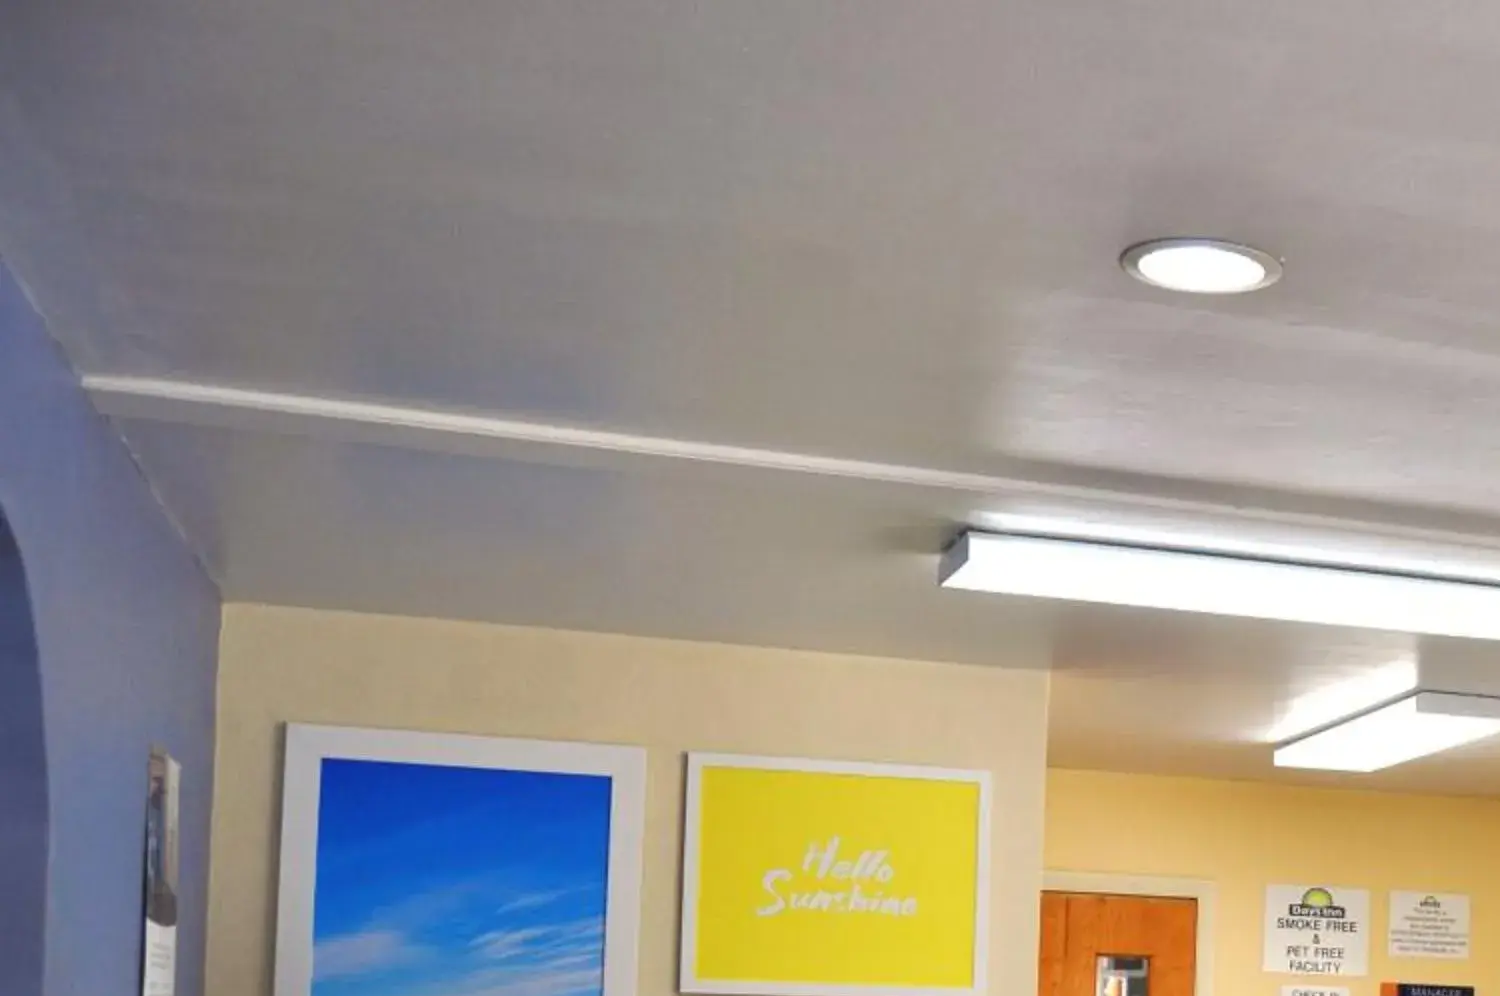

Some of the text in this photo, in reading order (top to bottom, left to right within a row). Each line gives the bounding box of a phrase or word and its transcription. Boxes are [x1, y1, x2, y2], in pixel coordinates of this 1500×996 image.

[802, 834, 894, 883] Hello
[756, 868, 918, 917] Sunshine
[1276, 917, 1358, 933] SMOKE FREE
[1286, 945, 1345, 959] PET FREE
[1288, 959, 1342, 973] FACILITY
